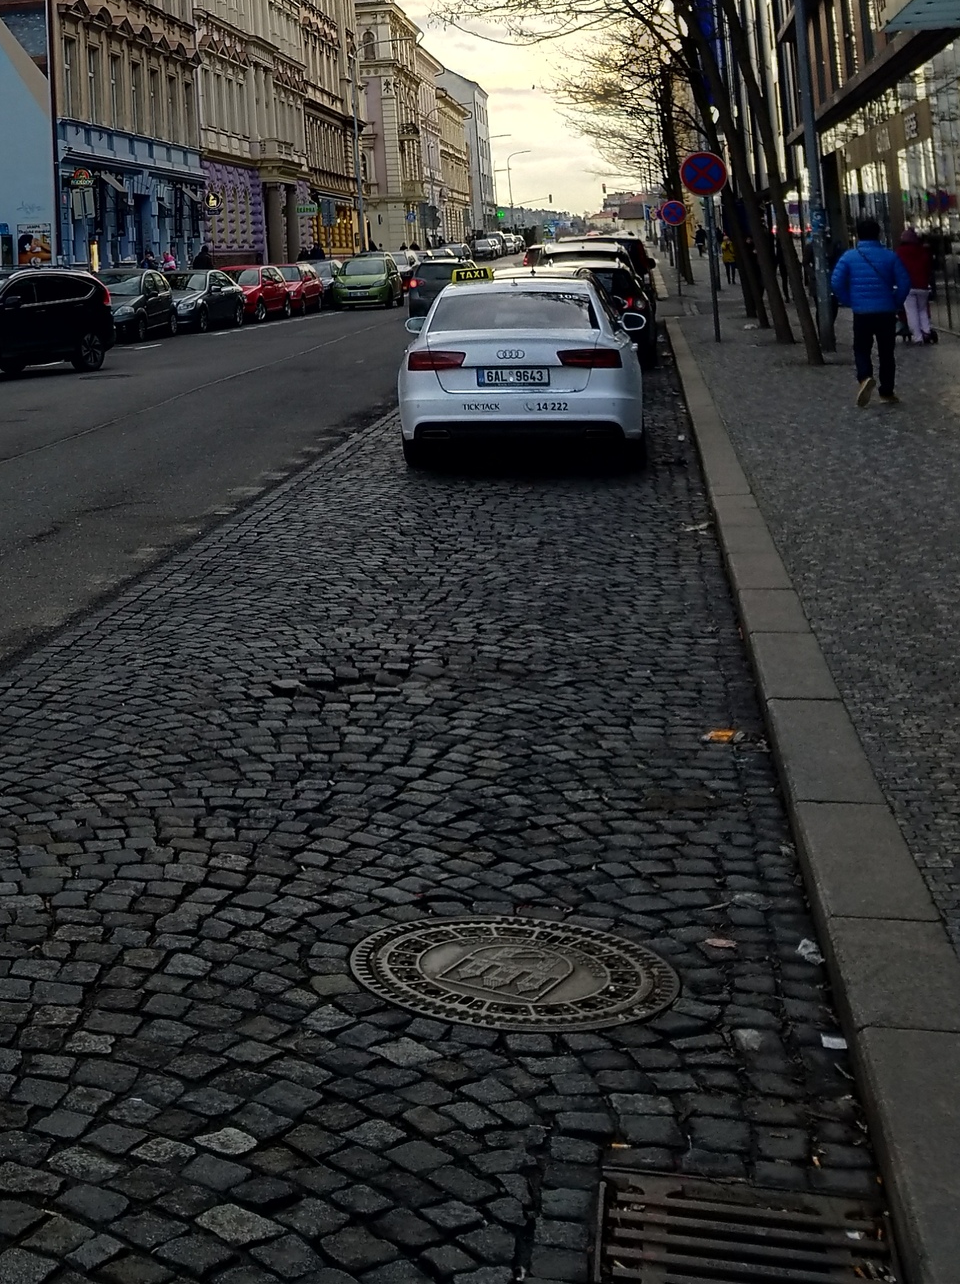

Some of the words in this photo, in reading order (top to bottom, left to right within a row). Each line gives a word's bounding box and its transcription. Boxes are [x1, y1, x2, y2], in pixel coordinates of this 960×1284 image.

[459, 269, 485, 280] TAXI
[486, 370, 507, 382] 6AL
[515, 370, 543, 382] 9643
[536, 402, 549, 411] 14
[551, 402, 569, 411] 222
